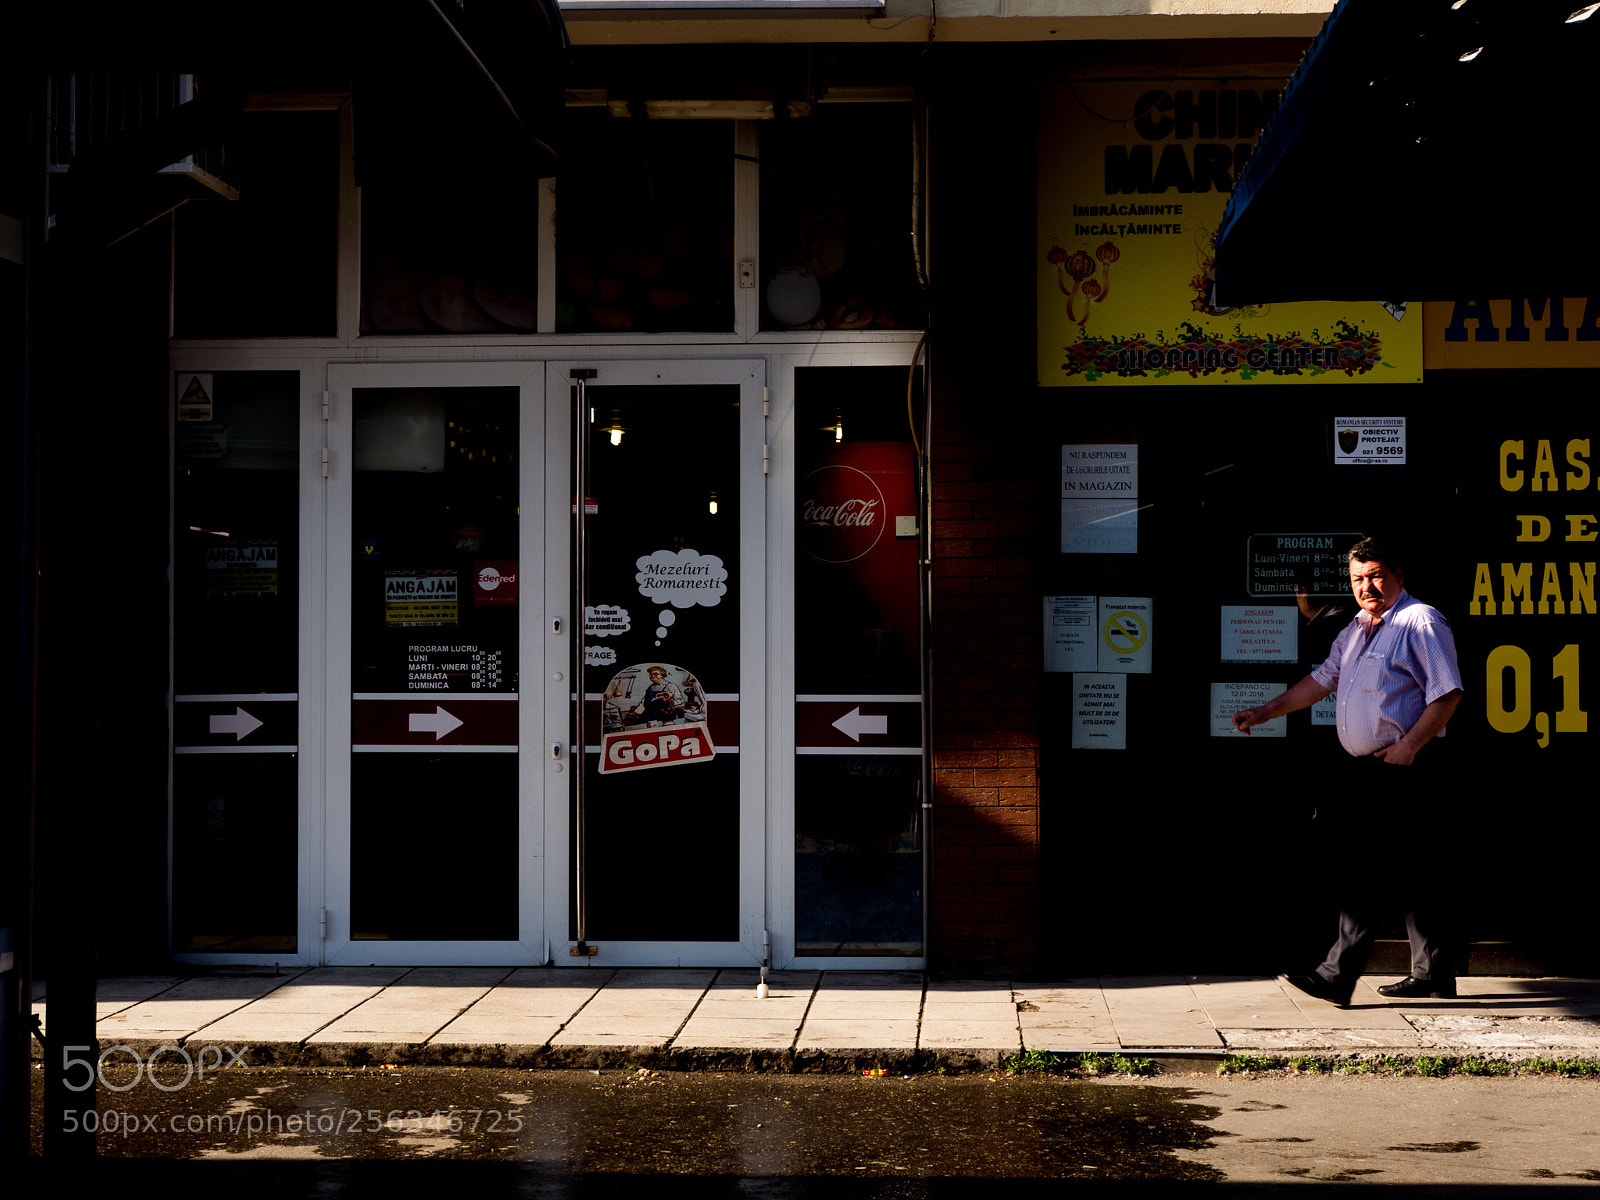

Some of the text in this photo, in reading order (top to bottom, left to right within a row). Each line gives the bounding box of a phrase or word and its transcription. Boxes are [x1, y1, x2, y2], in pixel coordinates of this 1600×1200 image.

[1117, 346, 1341, 369] SHOPPING CENTER
[1069, 451, 1127, 459] NU RASPUNDEM
[1376, 446, 1404, 455] 9569
[1066, 465, 1130, 474] DE LUCRURILE UITATE
[1499, 438, 1600, 492] CAS
[1064, 481, 1132, 491] IN MAGAZIN
[1516, 514, 1599, 542] DE
[1276, 537, 1334, 549] PROGRAM
[644, 562, 710, 576] Mezeluri
[479, 574, 516, 583] Edenred
[643, 577, 721, 589] Romanesti
[1469, 561, 1597, 616] AMAN
[1486, 643, 1588, 749] 0,1
[608, 733, 701, 765] GoPa
